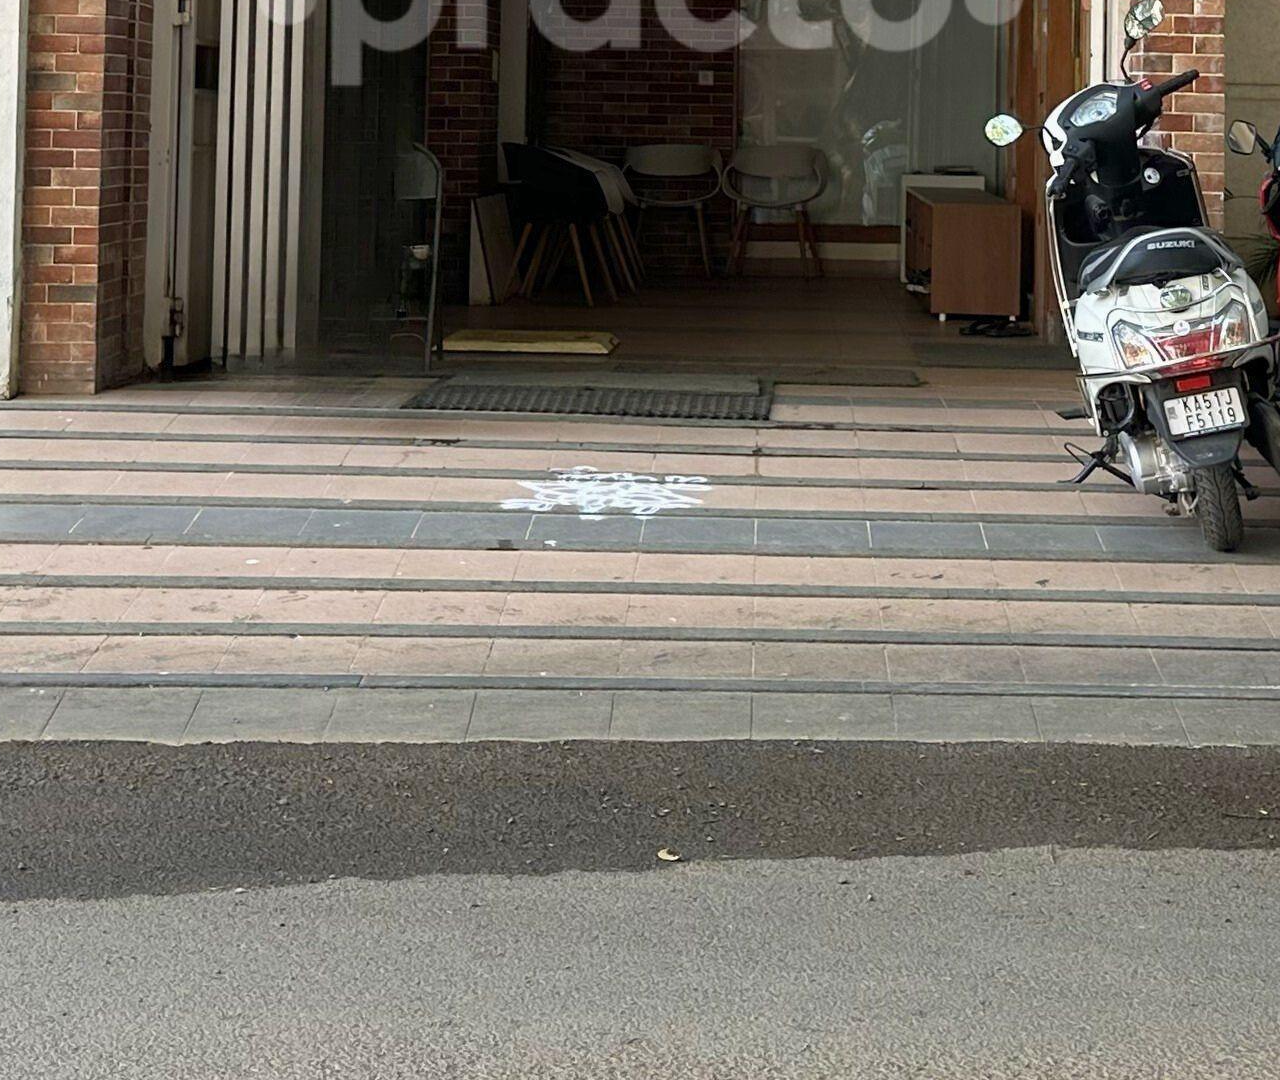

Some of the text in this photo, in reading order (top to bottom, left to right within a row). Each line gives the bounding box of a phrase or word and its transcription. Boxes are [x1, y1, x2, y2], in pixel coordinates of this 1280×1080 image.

[1146, 239, 1195, 250] SUZUKI
[1181, 389, 1232, 414] KA51J
[1186, 407, 1237, 431] F5119
